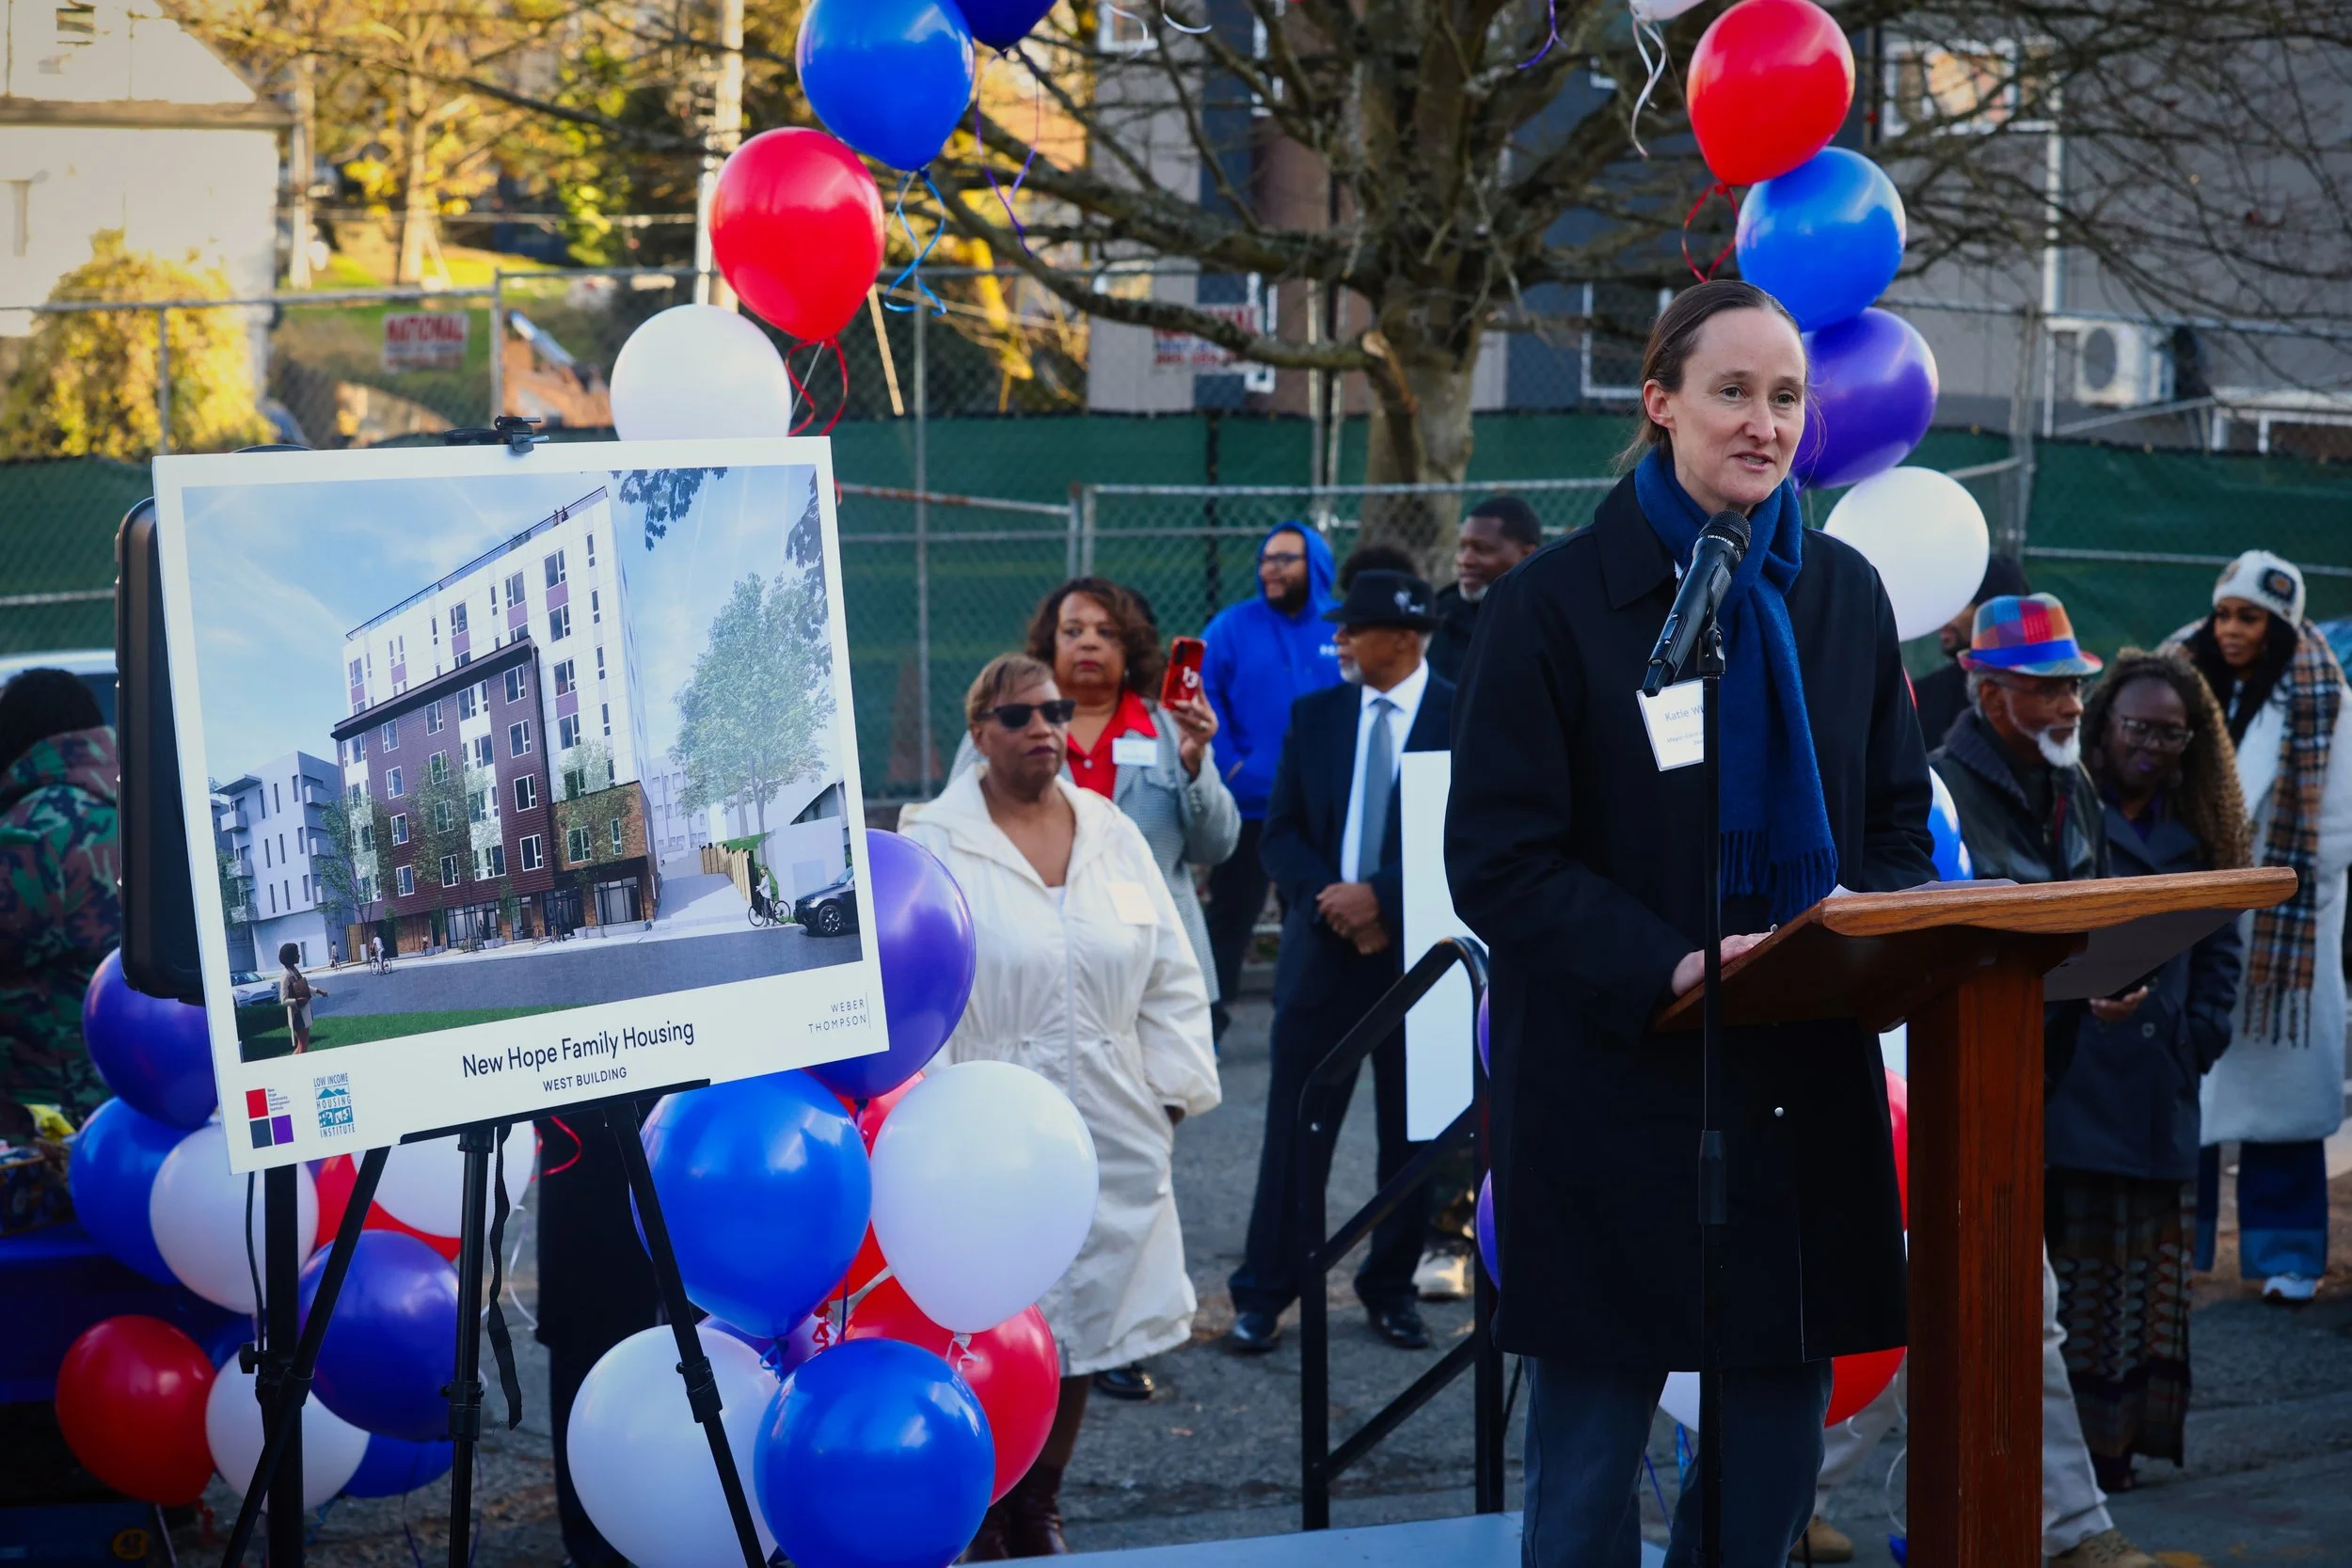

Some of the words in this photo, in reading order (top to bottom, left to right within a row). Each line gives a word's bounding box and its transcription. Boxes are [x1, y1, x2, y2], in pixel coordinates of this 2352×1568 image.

[1664, 708, 1690, 721] Katie
[831, 999, 865, 1012] WEBER
[808, 1014, 866, 1034] THOMPSON
[462, 1053, 503, 1078] New
[508, 1046, 558, 1071] Hope
[562, 1030, 618, 1060] Family
[623, 1020, 694, 1050] Housing
[313, 1077, 326, 1087] LOW
[327, 1072, 349, 1085] INCOME
[543, 1076, 573, 1092] WEST
[577, 1067, 628, 1086] BUILDING
[316, 1095, 352, 1110] HOUSING
[320, 1123, 356, 1138] INSTITUTE
